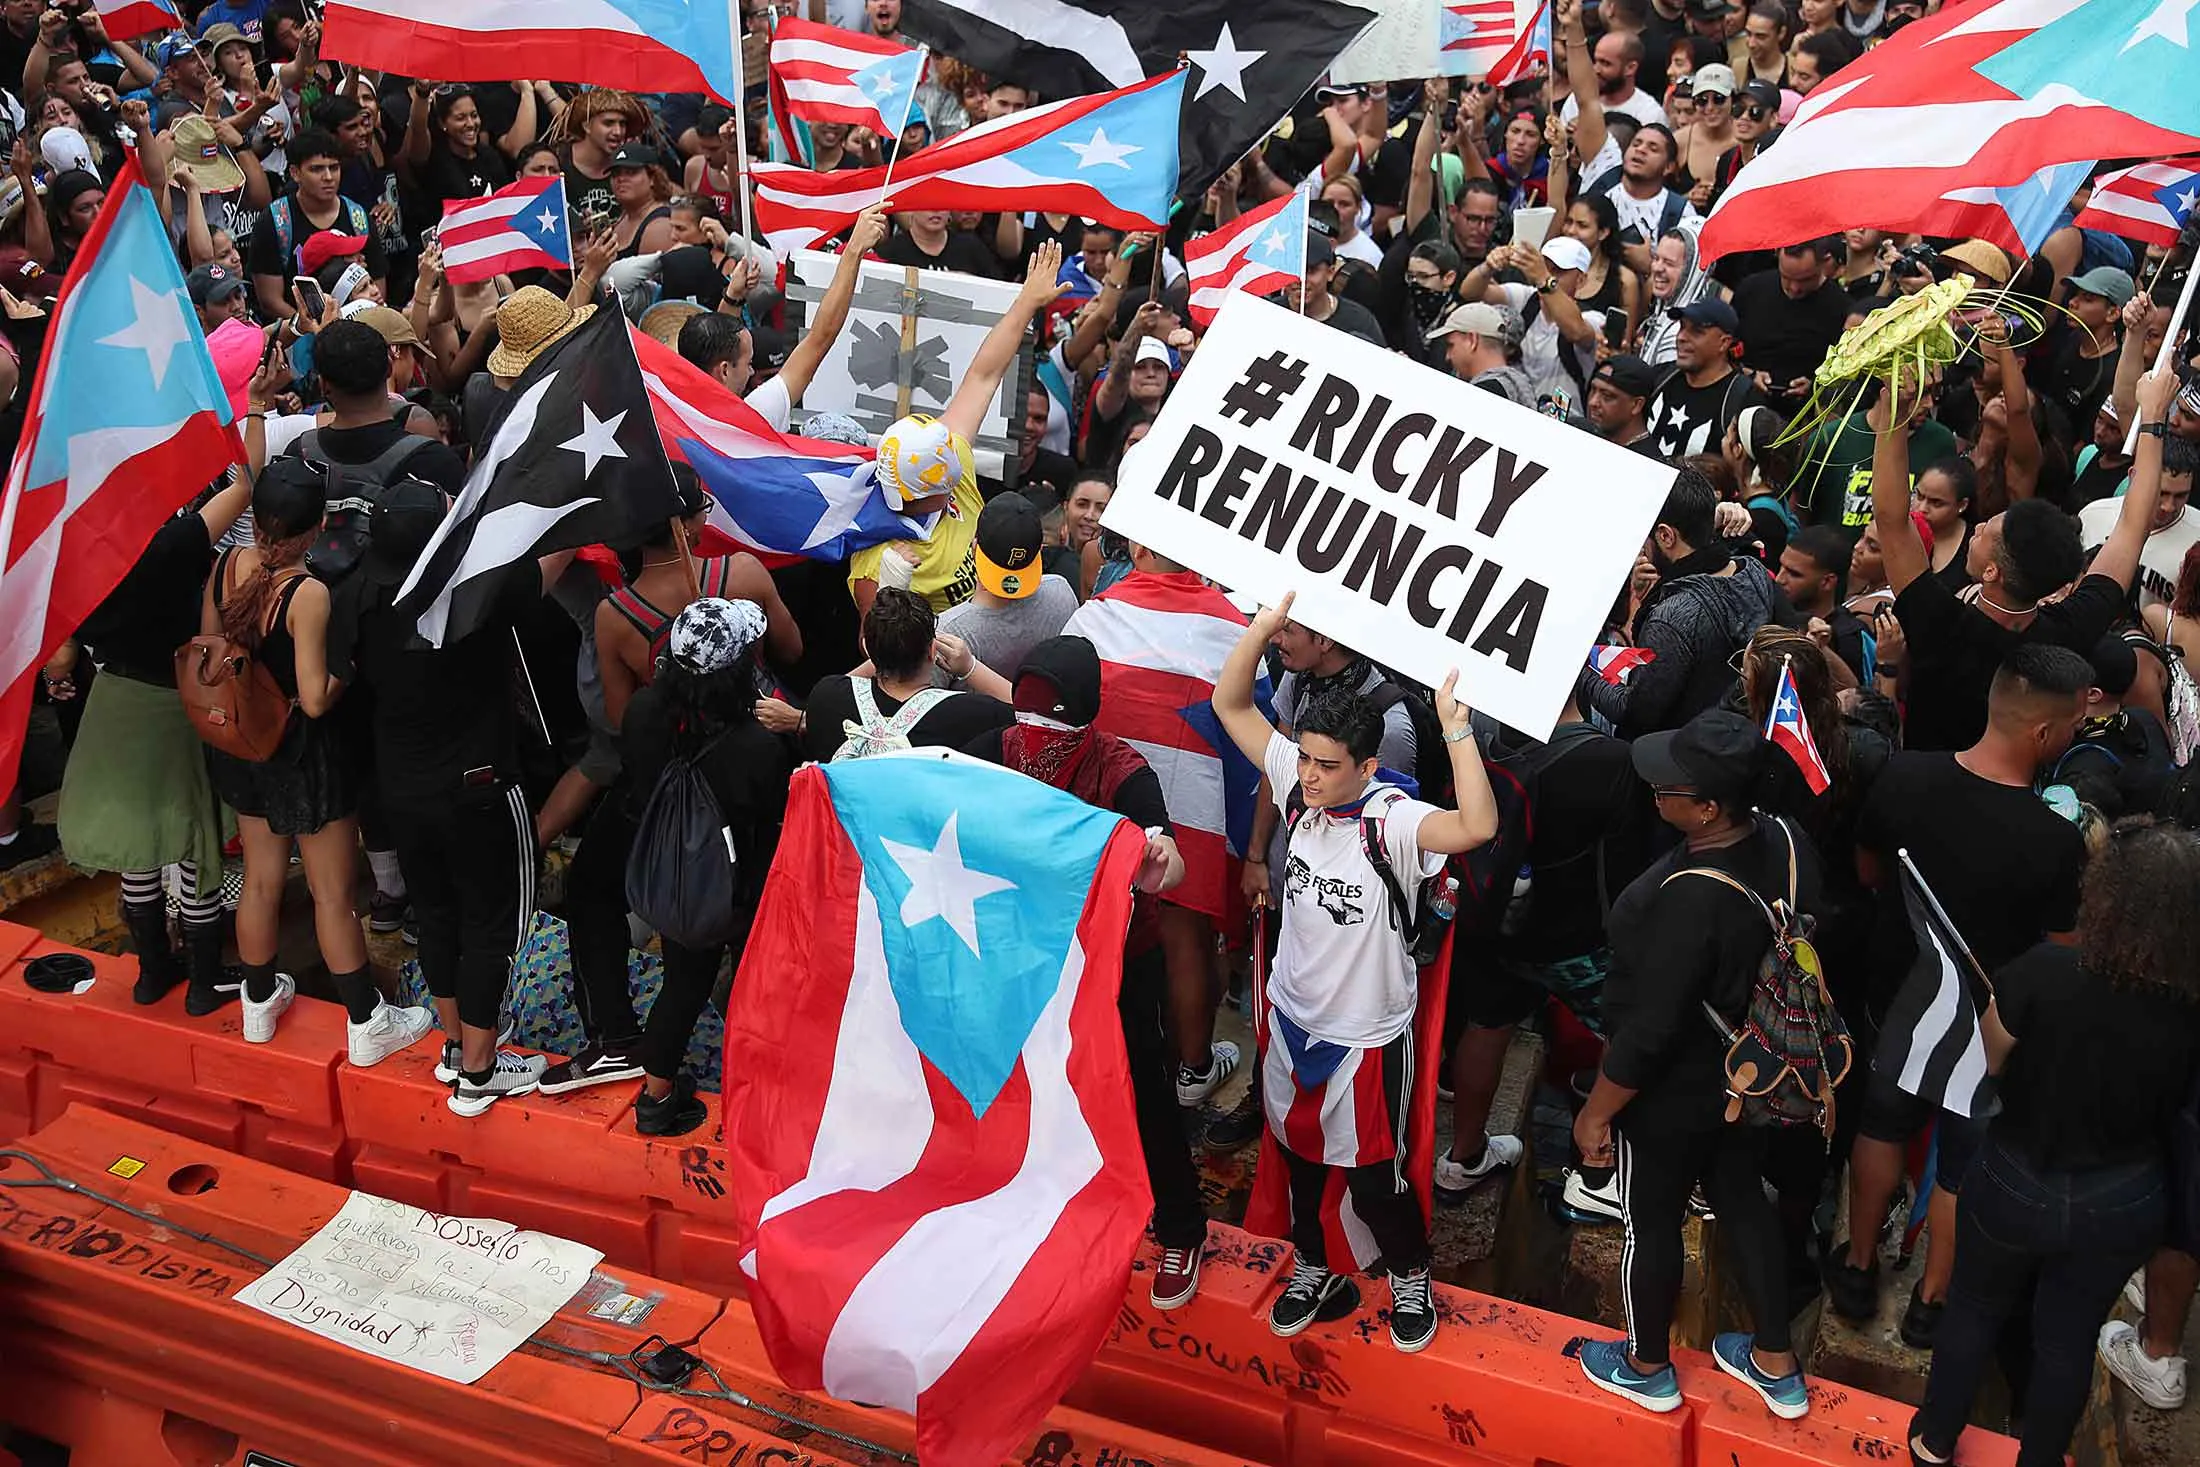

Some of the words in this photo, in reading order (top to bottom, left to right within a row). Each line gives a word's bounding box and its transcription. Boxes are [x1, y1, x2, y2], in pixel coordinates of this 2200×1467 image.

[1219, 350, 1548, 538] #RICKY
[1154, 423, 1548, 674] RENUNCIA
[1312, 876, 1362, 899] FECALES
[330, 1218, 421, 1259] quitaron
[288, 1255, 327, 1282] Pero
[333, 1246, 405, 1280] Salud
[529, 1257, 571, 1285] nos
[267, 1277, 402, 1344] Dignidad
